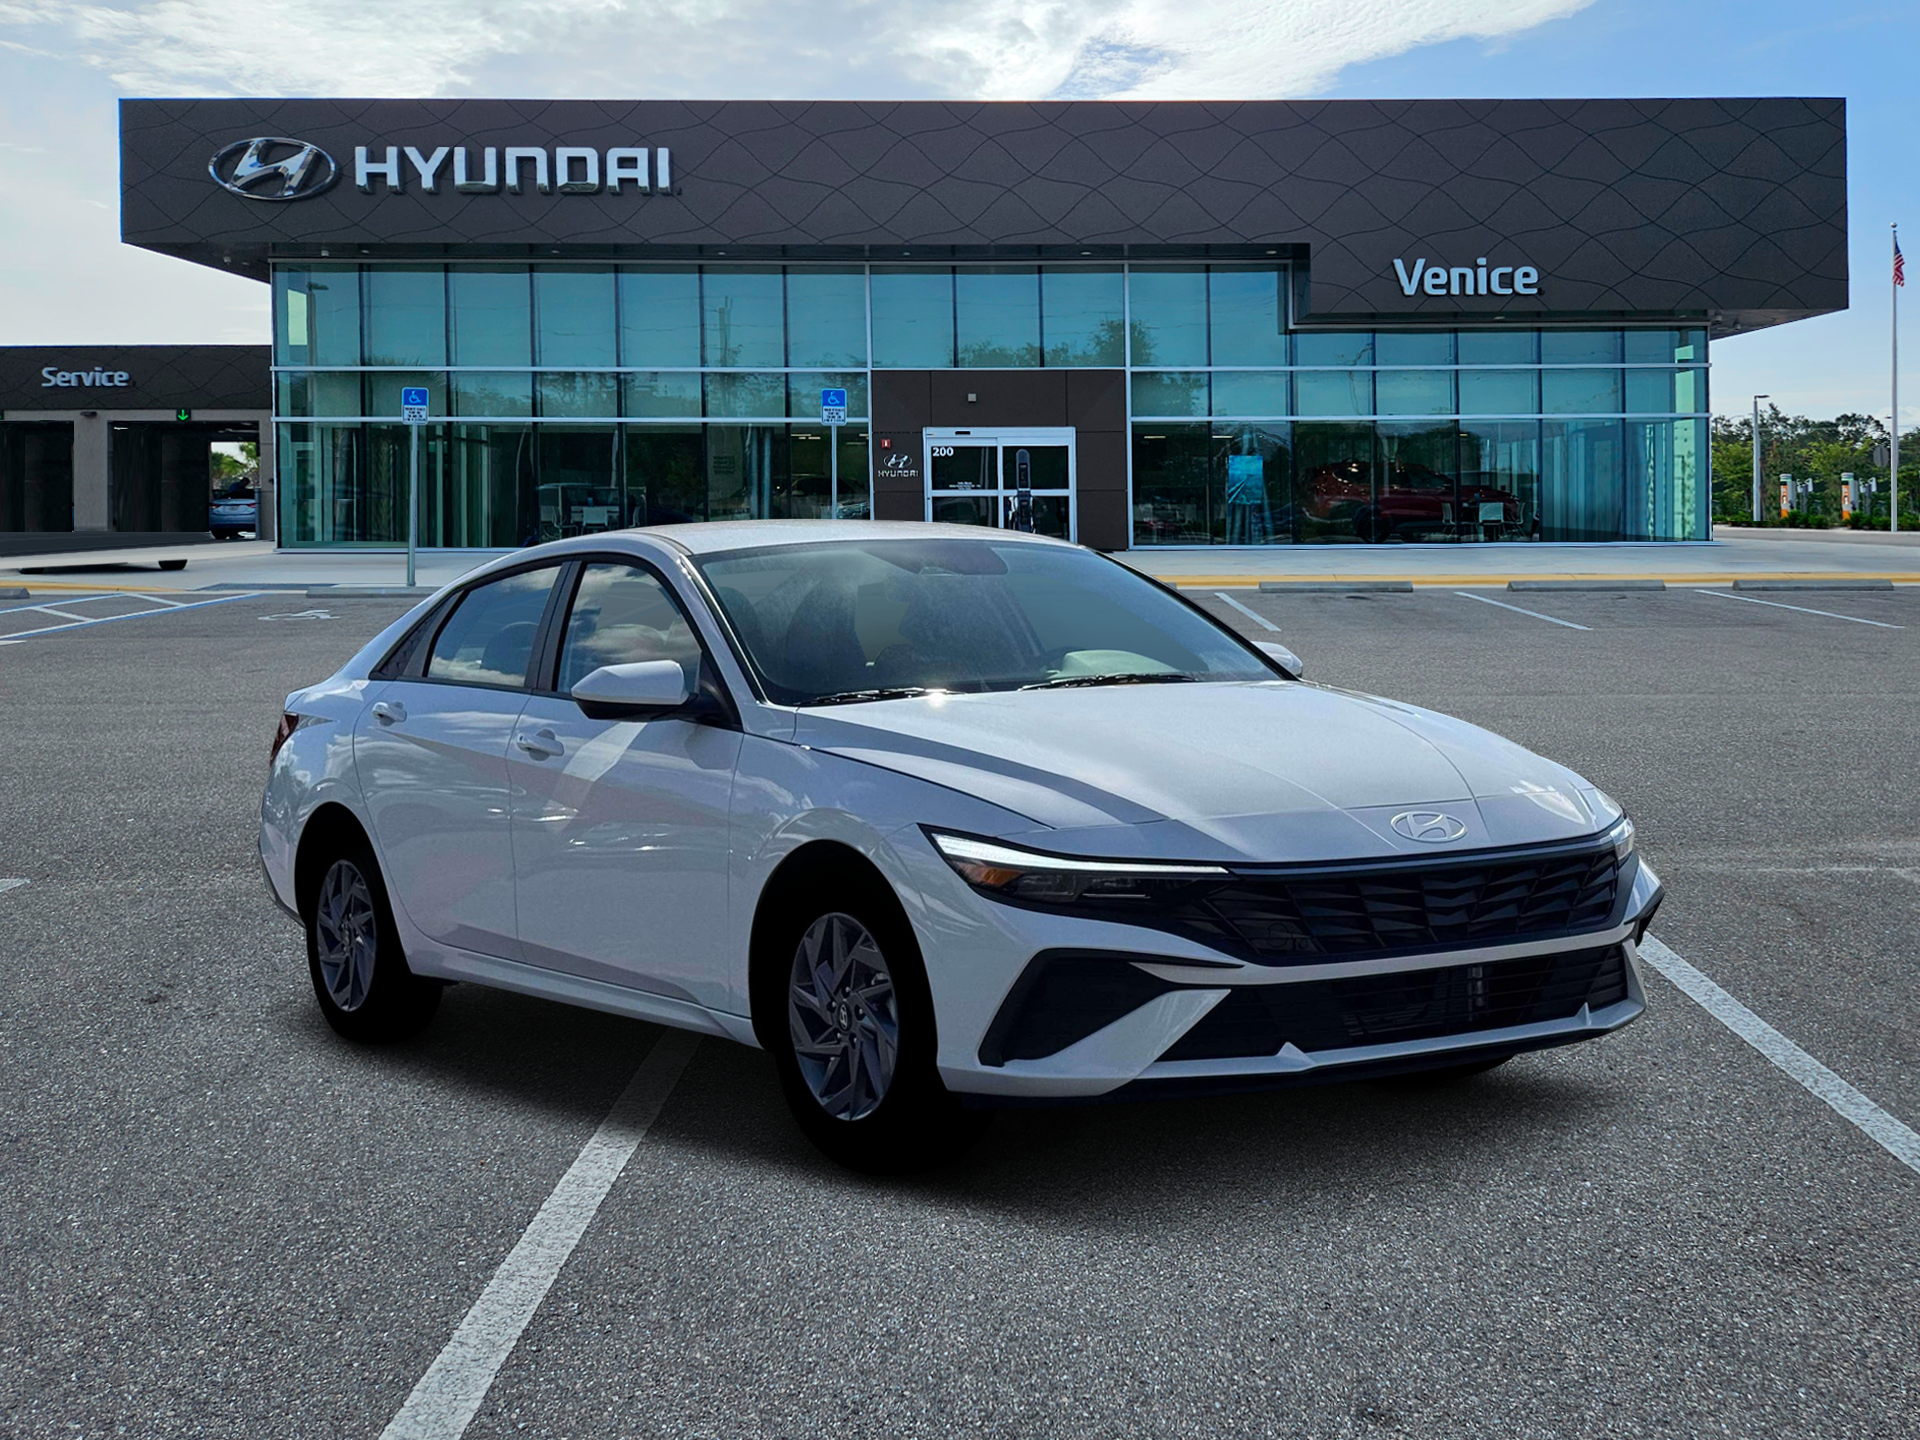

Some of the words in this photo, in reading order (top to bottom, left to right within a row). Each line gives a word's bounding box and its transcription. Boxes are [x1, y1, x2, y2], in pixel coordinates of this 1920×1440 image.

[354, 145, 670, 194] HYUNDAI
[1392, 257, 1539, 296] Venice
[41, 366, 130, 387] Service
[932, 446, 954, 457] 200
[877, 470, 919, 478] HYUNDAI
